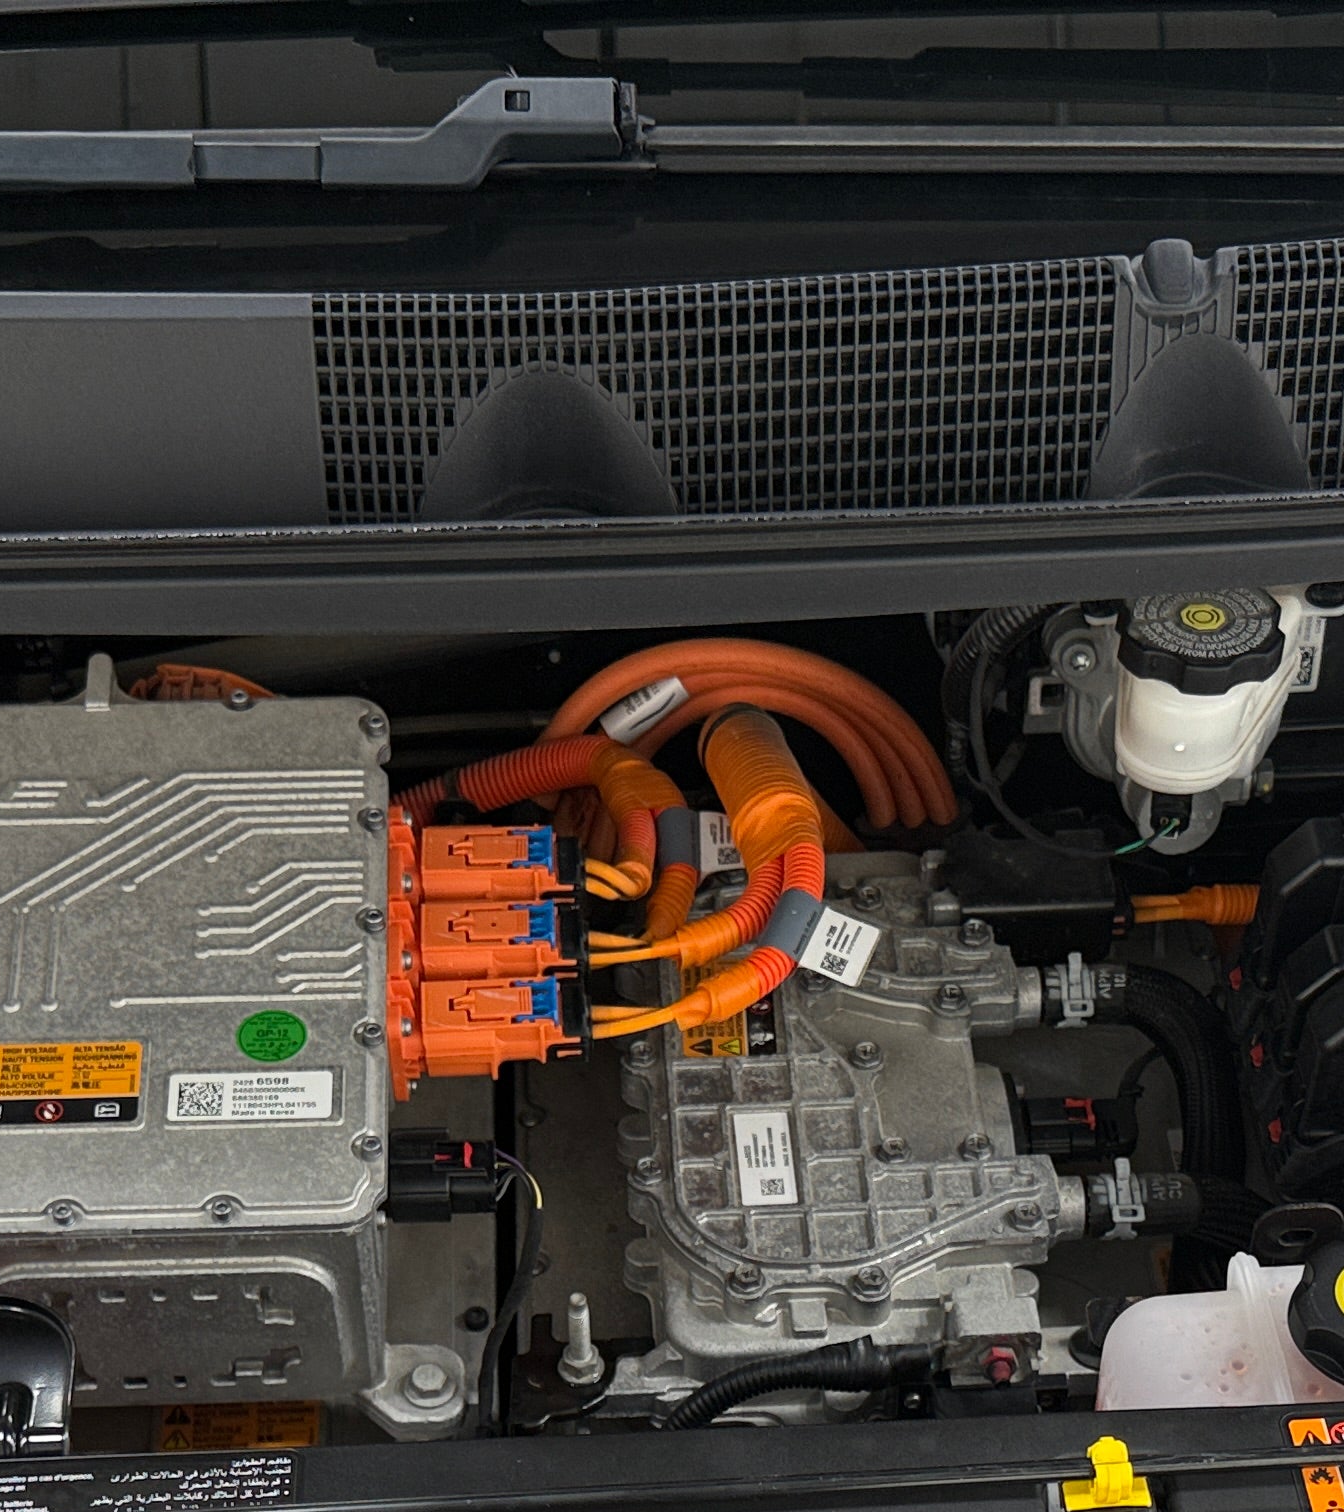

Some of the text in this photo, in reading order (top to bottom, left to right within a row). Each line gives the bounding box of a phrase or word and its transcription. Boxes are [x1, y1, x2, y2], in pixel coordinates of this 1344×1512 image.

[1179, 647, 1206, 658] FROM
[23, 1046, 58, 1054] VOLTAGE
[73, 1045, 93, 1053] ALTA
[2, 1054, 64, 1063] HAUTE TENSION
[22, 1072, 55, 1080] VOLTAJE
[256, 1077, 289, 1085] 6598
